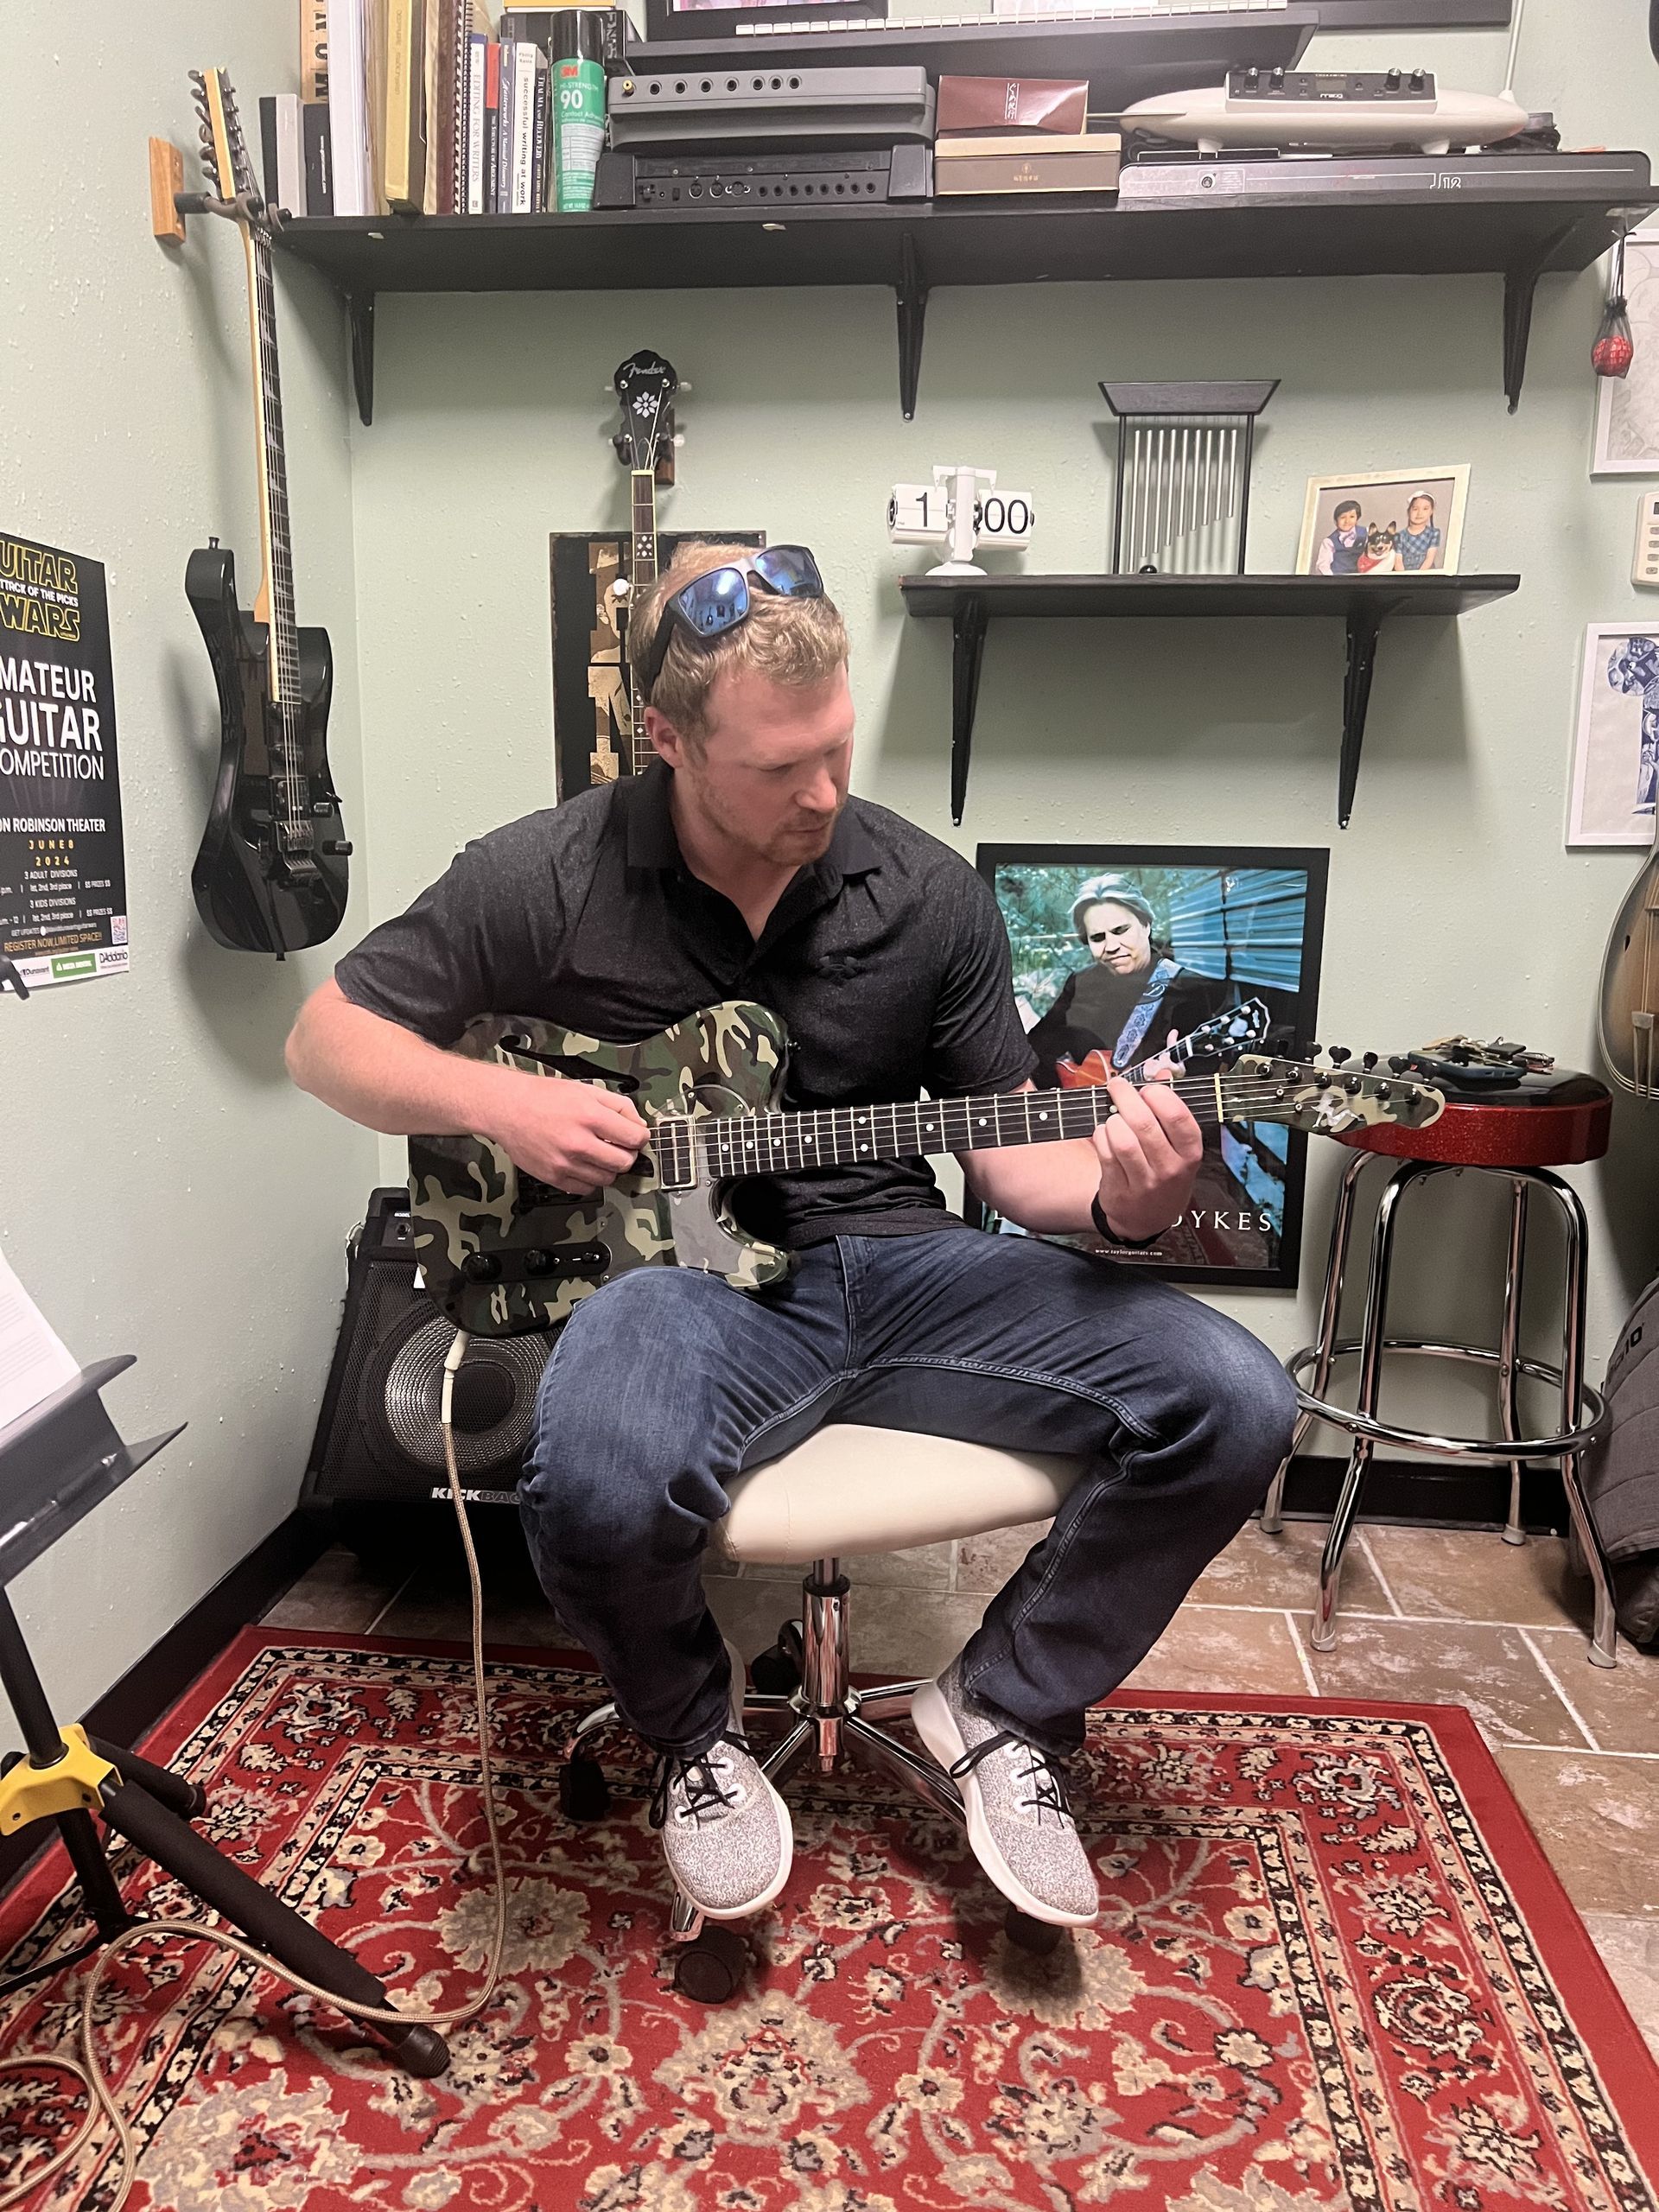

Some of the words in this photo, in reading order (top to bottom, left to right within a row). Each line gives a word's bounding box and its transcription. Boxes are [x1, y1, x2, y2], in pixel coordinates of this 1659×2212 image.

[561, 65, 578, 78] 3M
[473, 74, 481, 114] EDITING
[537, 76, 545, 108] TRAUMA
[560, 89, 583, 110] 90
[536, 120, 544, 159] RECOVERY
[472, 140, 480, 182] WRITERS
[520, 168, 526, 178] at
[623, 360, 666, 378] Fender
[915, 492, 928, 527] 1
[984, 498, 1029, 535] 00
[27, 585, 39, 598] OF
[40, 588, 56, 603] THE
[56, 592, 79, 607] PICKS
[0, 593, 80, 641] WARS
[0, 655, 97, 703] MATEUR
[0, 696, 103, 752] UITAR
[0, 747, 105, 780] OMPETITION
[13, 817, 66, 832] ROBINSON
[66, 818, 106, 832] THEATER
[29, 839, 65, 850] JUNE
[35, 855, 70, 867] 2024
[24, 871, 29, 880] 3
[29, 870, 48, 879] ADULT
[50, 869, 78, 879] DIVISIONS
[29, 899, 34, 909] 3
[35, 899, 48, 908] KIDS
[48, 898, 76, 907] DIVISIONS
[4, 939, 36, 952] REGISTER
